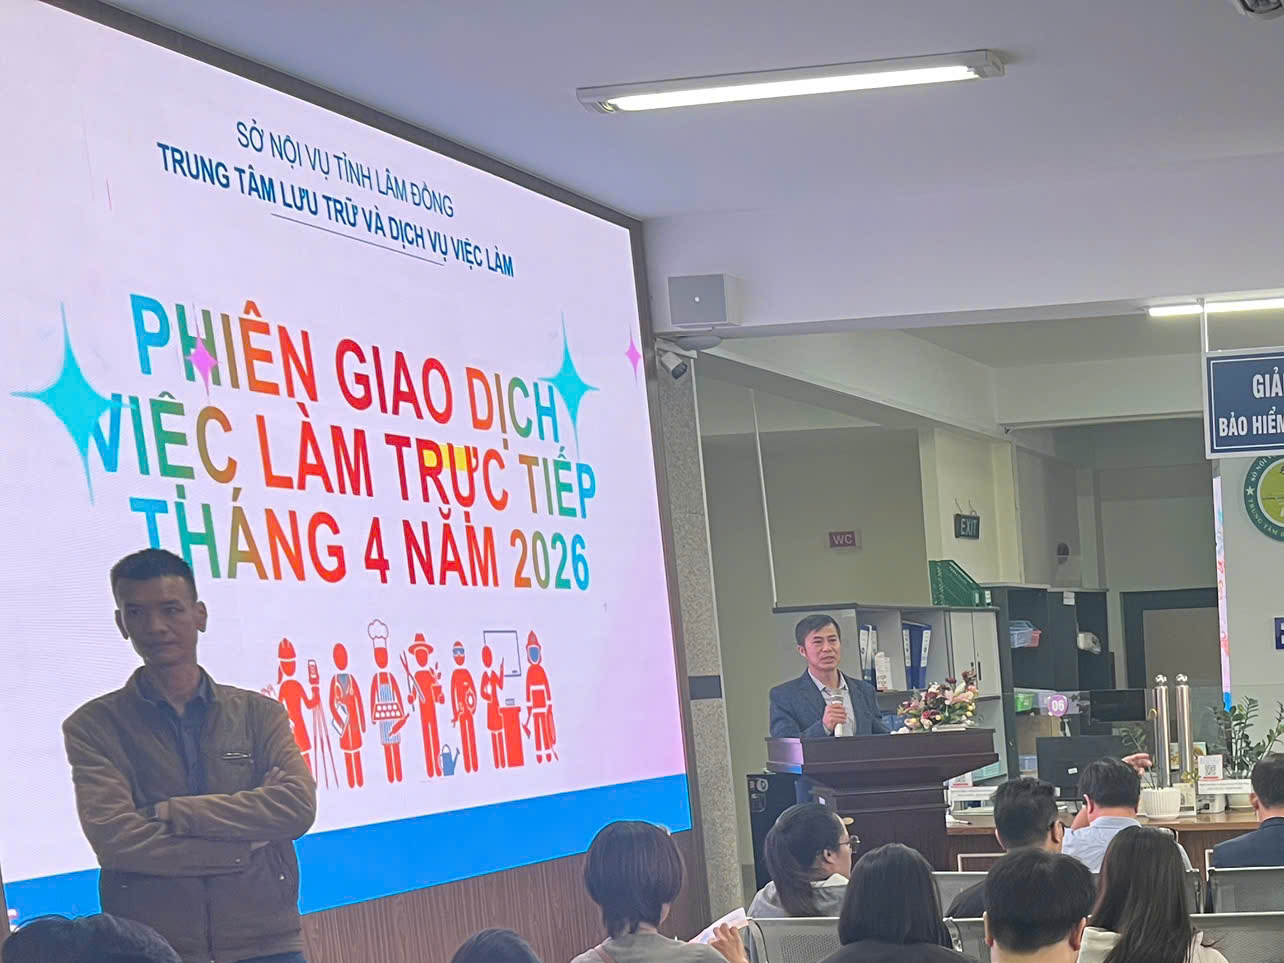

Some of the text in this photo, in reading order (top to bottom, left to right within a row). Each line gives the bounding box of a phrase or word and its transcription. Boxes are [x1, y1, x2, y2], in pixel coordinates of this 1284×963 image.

[156, 141, 514, 277] TRUNG TÂM LƯU TRỮ VÀ DỊCH VỤ VIỆC LÀM
[236, 118, 454, 218] SỞ NỘI VỤ TỈNH LÂM ĐỒNG
[129, 294, 560, 450] PHIÊN GIAO DỊCH
[88, 391, 596, 523] VIỆC LÀM TRỰC TIẾP
[1218, 411, 1248, 437] BẢO
[129, 487, 589, 591] THÁNG 4 NĂM 2026
[832, 534, 853, 545] WC
[960, 518, 978, 536] EXIT
[1051, 699, 1065, 712] 06
